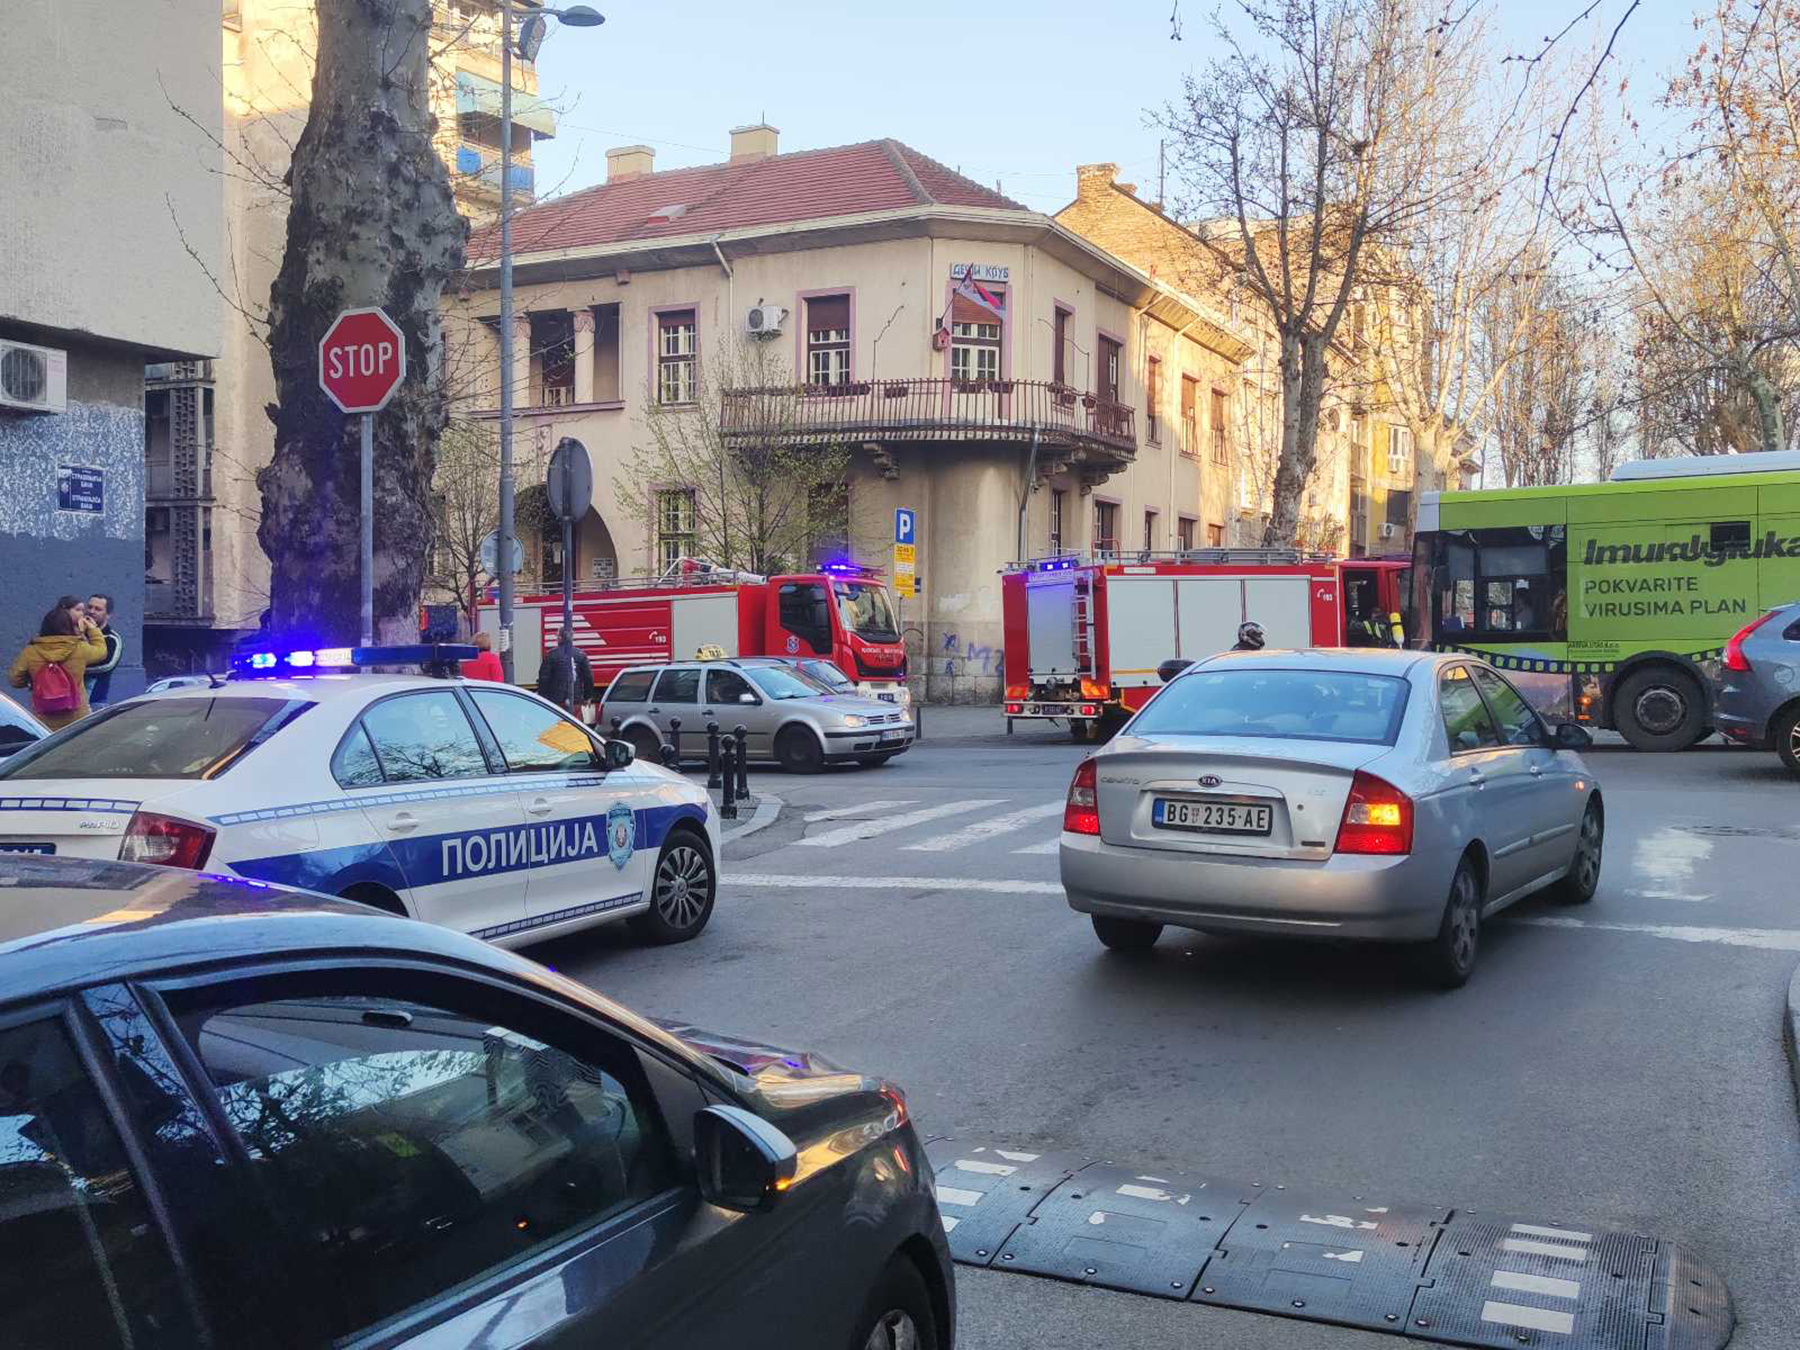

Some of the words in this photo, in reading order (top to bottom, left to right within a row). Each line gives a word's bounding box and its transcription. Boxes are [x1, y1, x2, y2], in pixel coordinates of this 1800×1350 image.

[329, 341, 394, 379] STOP
[899, 512, 912, 541] P
[1584, 576, 1698, 595] POKVARITE
[1584, 600, 1684, 617] VIRUSIMA
[1690, 599, 1746, 615] PLAN
[655, 634, 667, 644] 193
[1167, 803, 1189, 823] BG
[441, 821, 598, 876] ПОЛИЦИЈА
